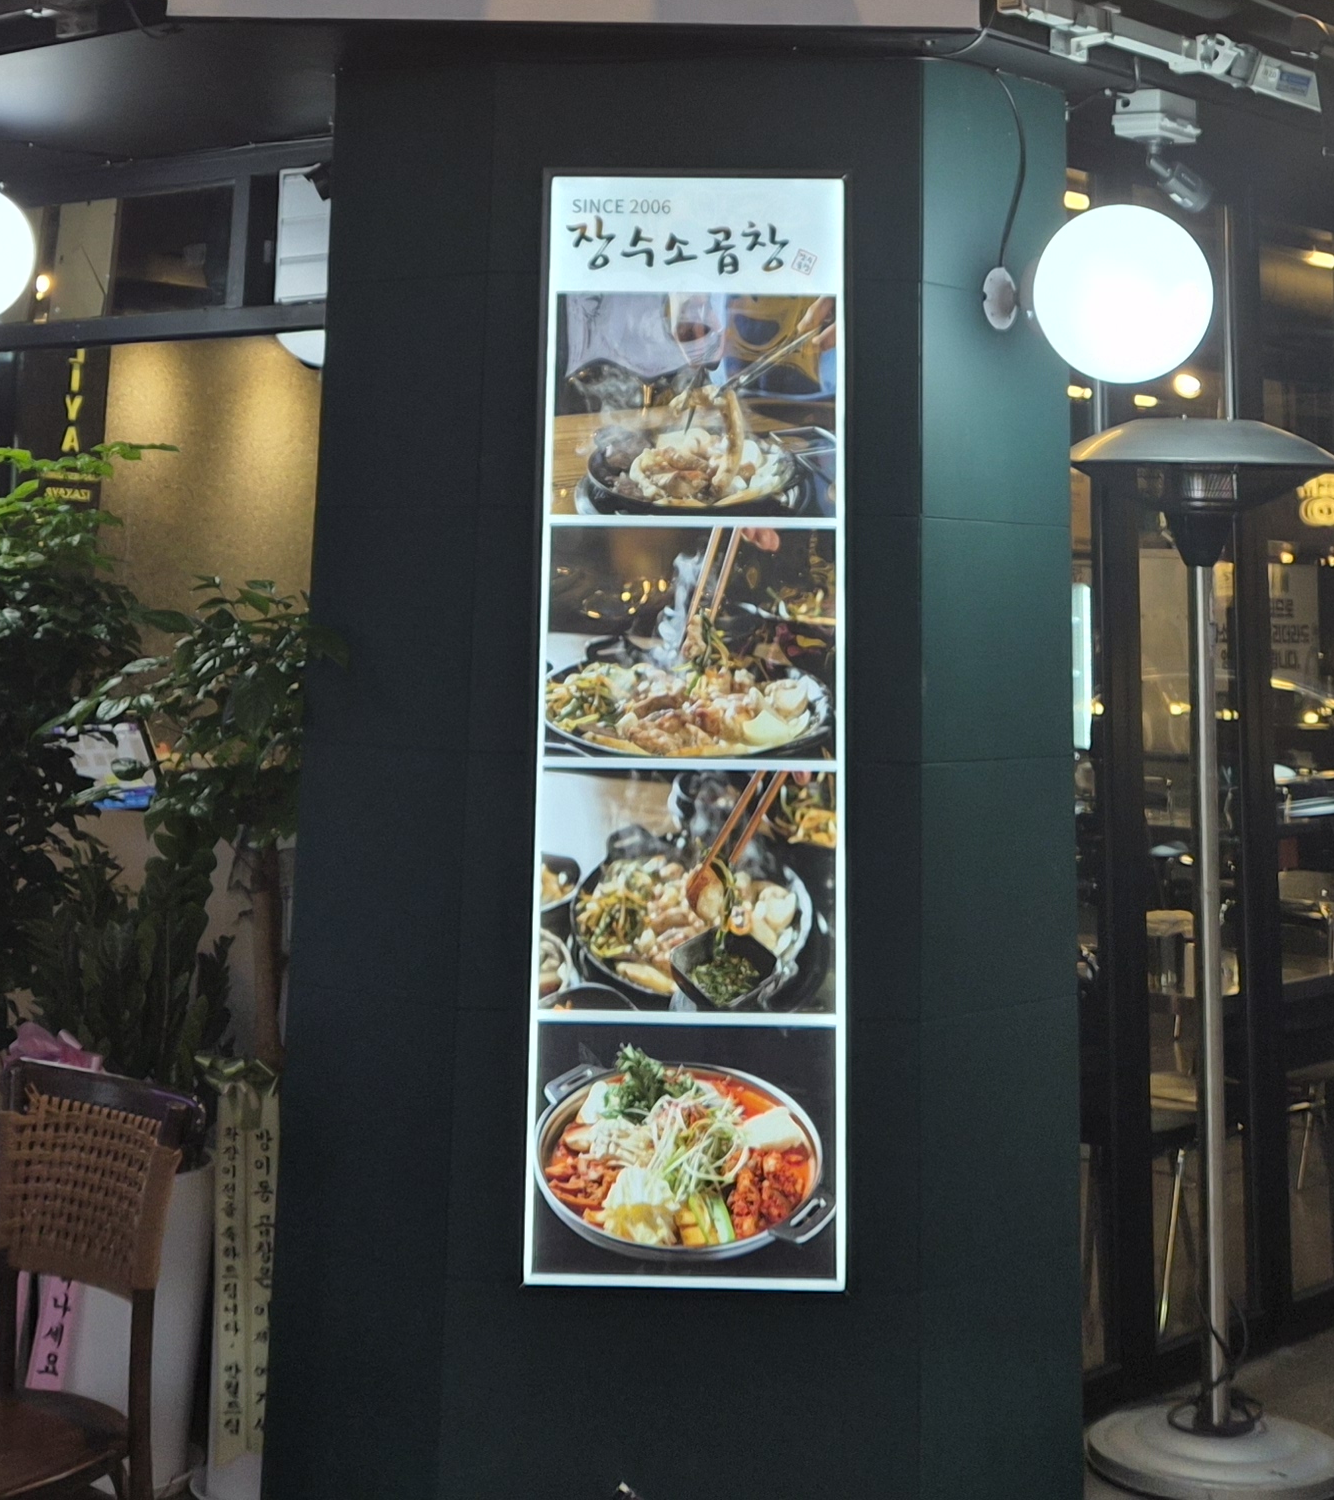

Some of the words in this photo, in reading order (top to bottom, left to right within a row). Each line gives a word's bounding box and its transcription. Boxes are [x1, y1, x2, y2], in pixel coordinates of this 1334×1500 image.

[571, 198, 625, 214] SINCE
[629, 198, 672, 215] 2006
[565, 215, 790, 276] 장수소곱창
